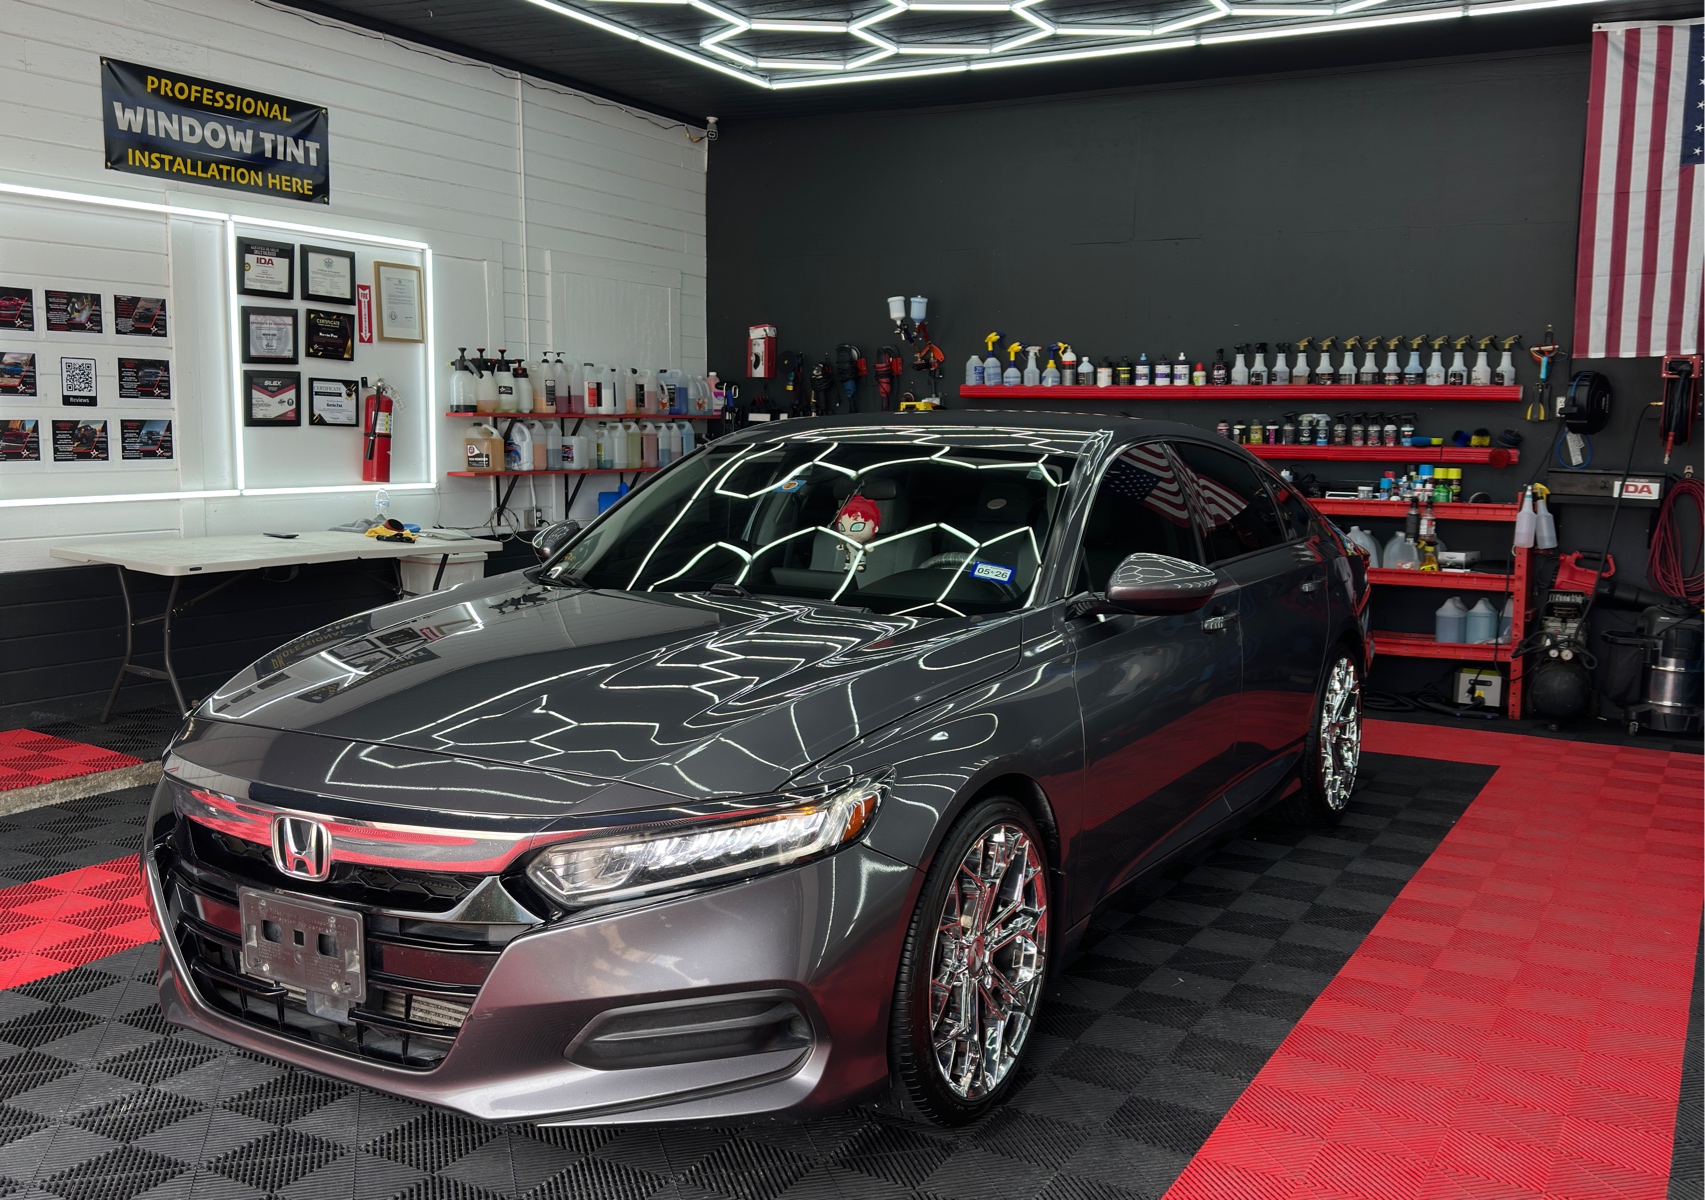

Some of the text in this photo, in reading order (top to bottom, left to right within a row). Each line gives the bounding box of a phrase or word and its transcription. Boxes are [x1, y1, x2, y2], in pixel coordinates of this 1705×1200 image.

[147, 75, 292, 122] PROFESSIONAL
[113, 101, 320, 167] WINDOW TINT
[127, 148, 313, 195] INSTALLATION HERE
[256, 257, 275, 266] IDA
[316, 318, 340, 326] CERTIFICATE
[1624, 483, 1653, 495] DA
[977, 567, 1009, 579] 05 26
